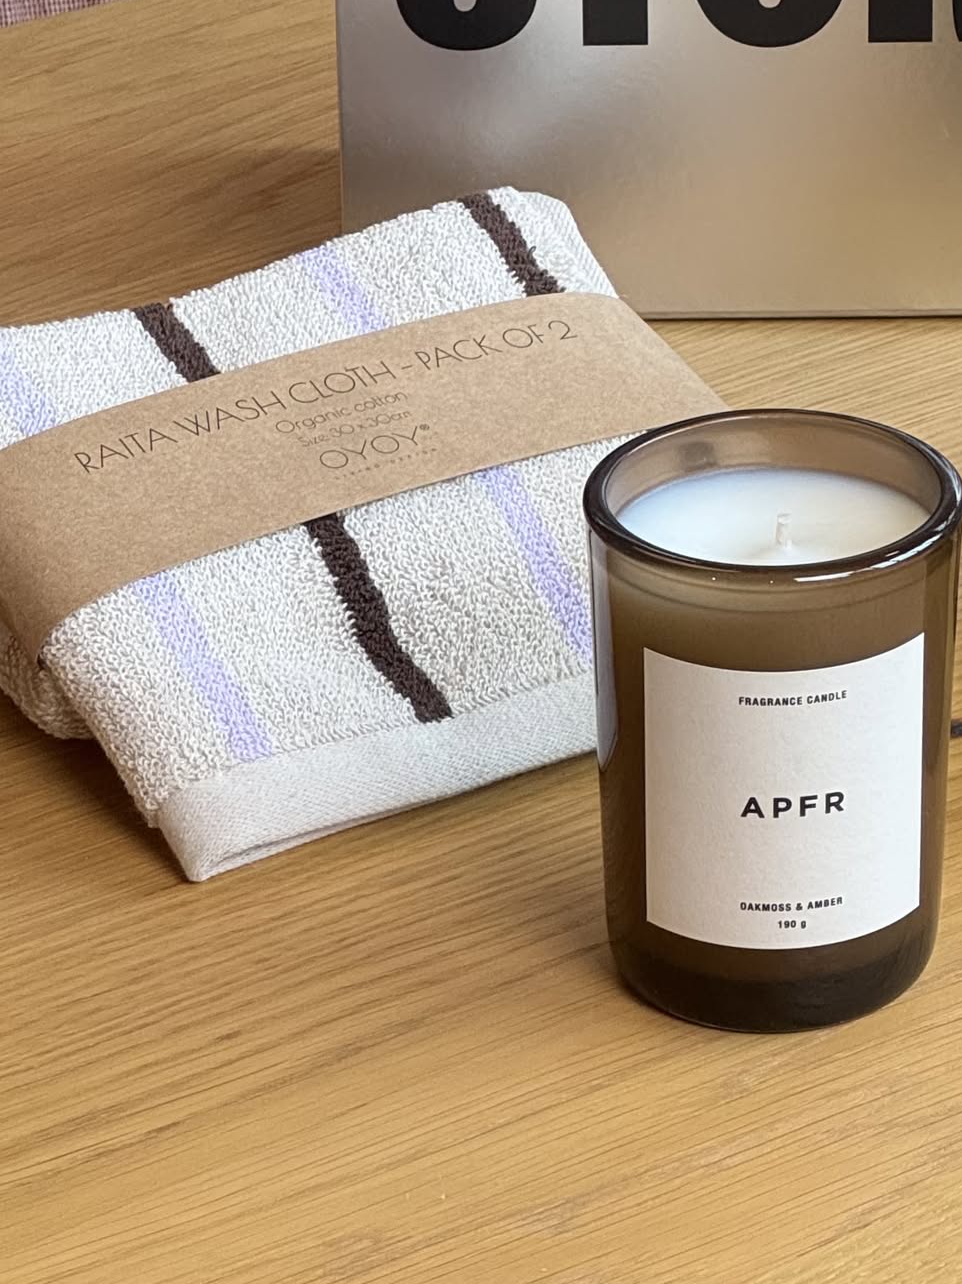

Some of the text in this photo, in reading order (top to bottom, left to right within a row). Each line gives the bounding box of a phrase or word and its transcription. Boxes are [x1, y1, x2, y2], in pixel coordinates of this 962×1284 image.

[73, 427, 179, 474] RAITA
[173, 390, 288, 438] WASH
[288, 360, 397, 404] CLOTH
[414, 334, 503, 371] PACK
[502, 323, 545, 349] OF
[547, 319, 578, 341] 2
[275, 391, 408, 433] Organic cotton
[329, 423, 355, 438] 30
[738, 689, 848, 707] FRAGRANCE CANDLE
[740, 790, 845, 819] APFR
[739, 895, 843, 913] OAKMOSS & AMBER
[776, 919, 807, 930] 190 g
